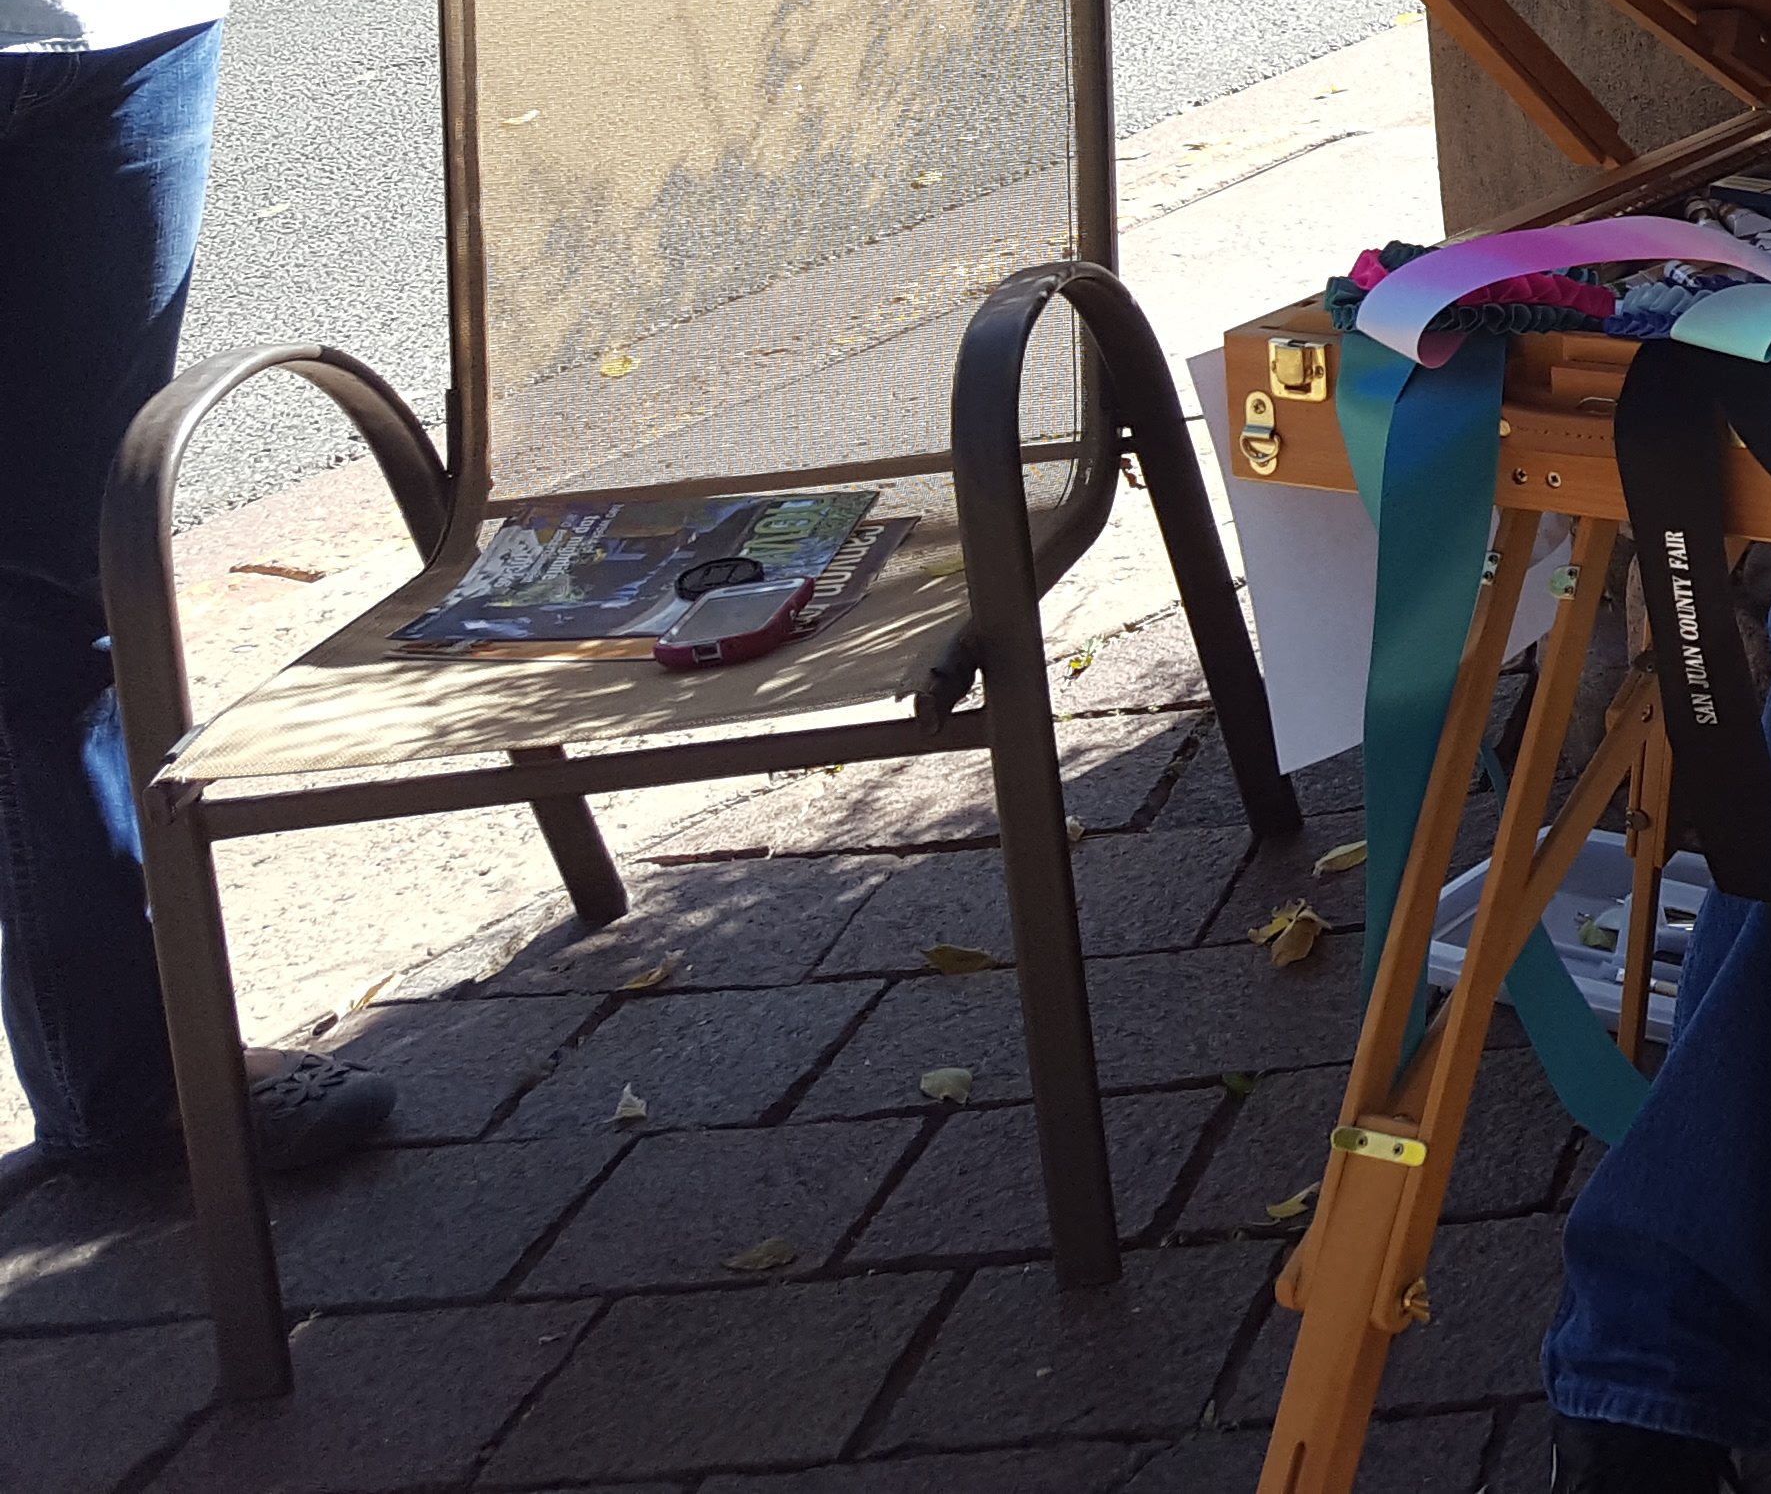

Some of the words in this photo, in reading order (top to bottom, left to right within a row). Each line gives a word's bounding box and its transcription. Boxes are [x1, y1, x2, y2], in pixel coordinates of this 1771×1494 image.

[569, 514, 601, 534] top
[540, 535, 588, 581] nightlife
[1665, 530, 1689, 570] FAIR
[1671, 574, 1699, 640] COUNTY
[1682, 645, 1710, 689] JUAN
[1691, 692, 1718, 725] SAN
